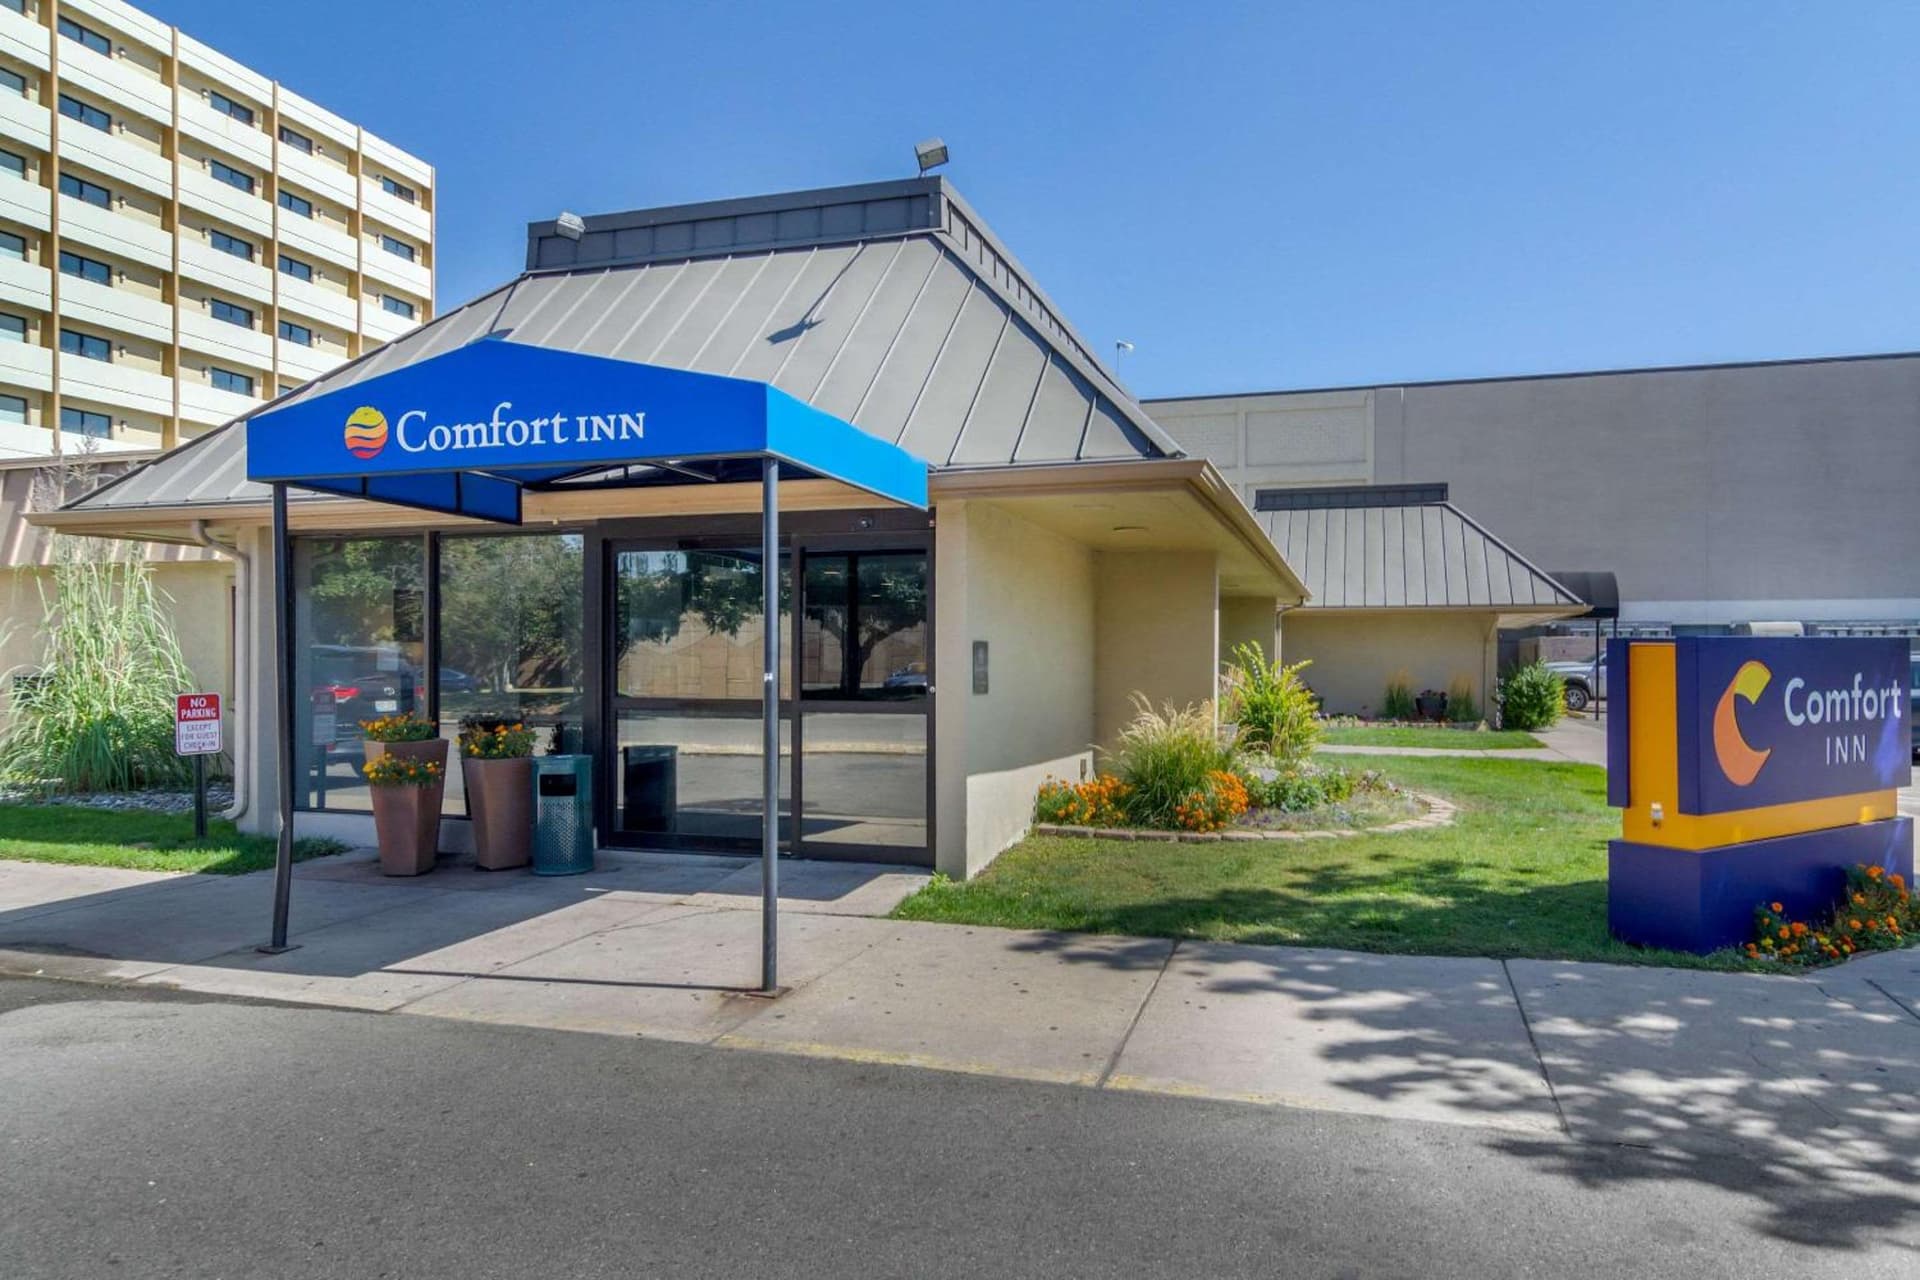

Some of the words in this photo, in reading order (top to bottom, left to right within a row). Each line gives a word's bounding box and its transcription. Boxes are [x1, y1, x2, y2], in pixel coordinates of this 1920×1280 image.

[396, 402, 568, 452] Comfort
[576, 412, 646, 442] INN
[181, 708, 216, 719] PARKING
[190, 698, 207, 708] NO
[1784, 672, 1902, 726] Comfort
[1826, 734, 1867, 765] INN
